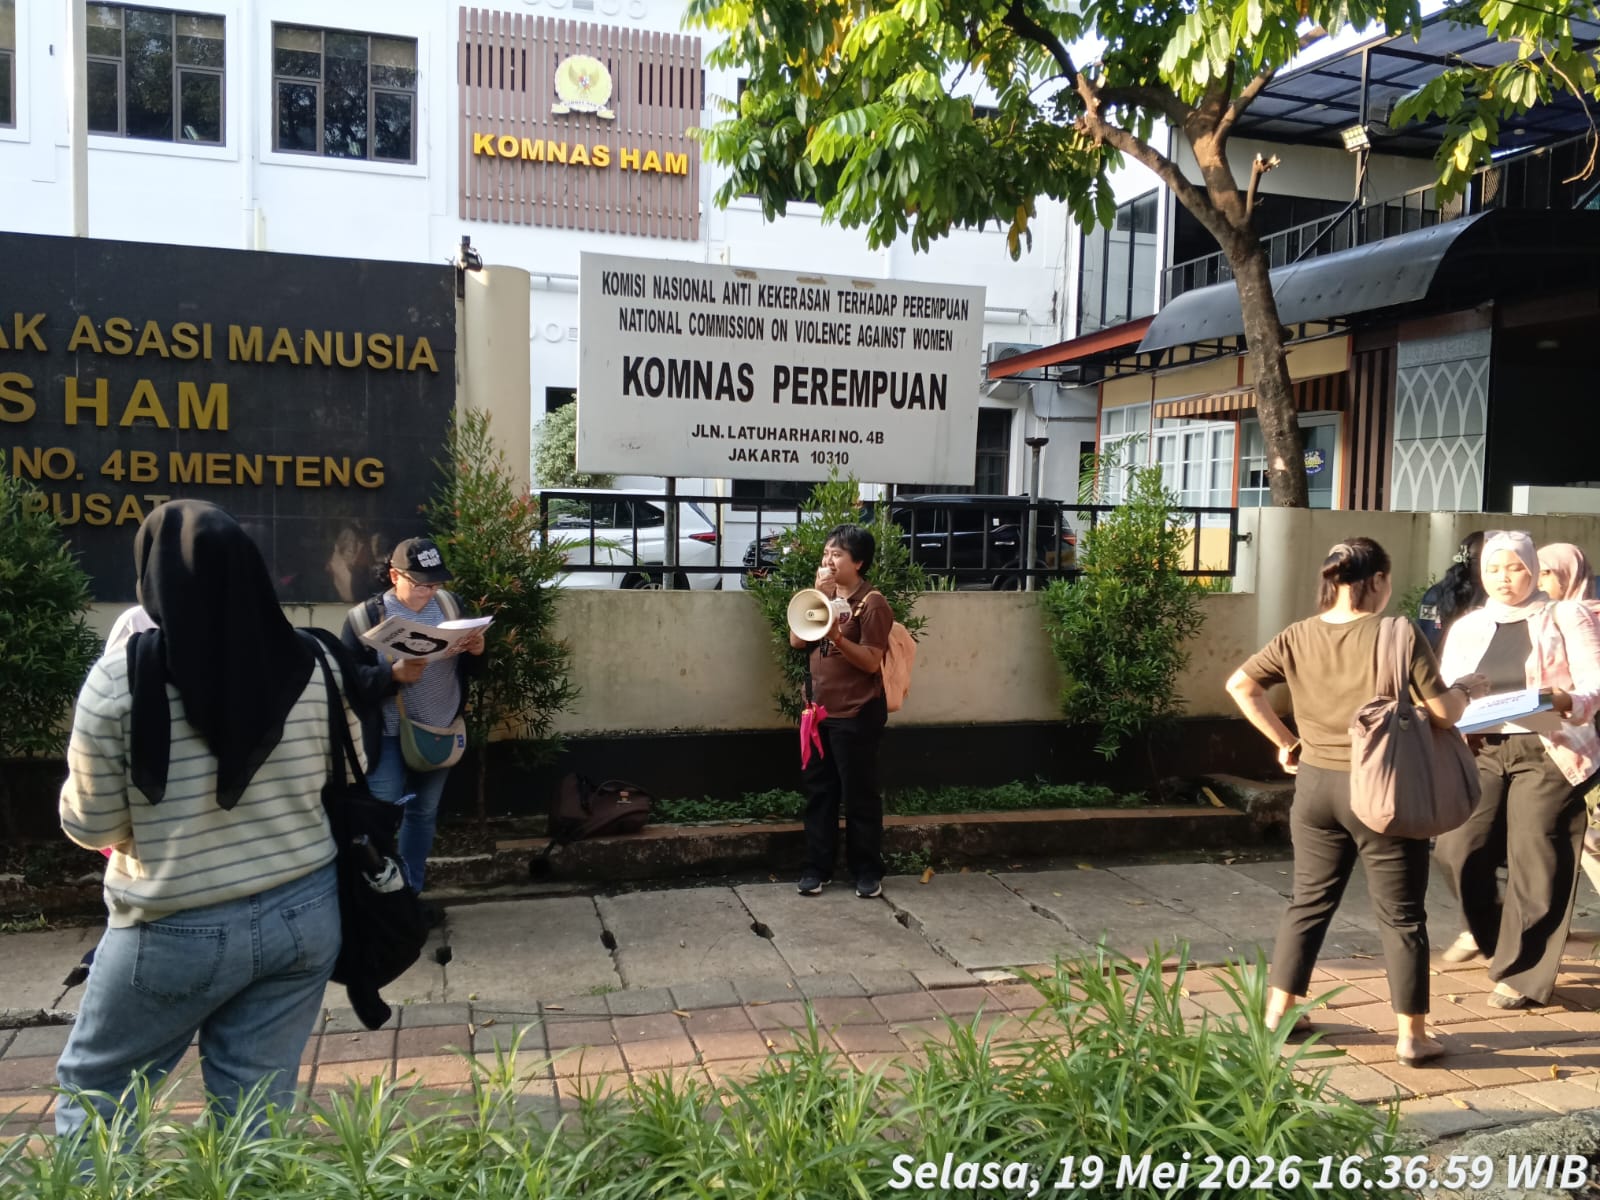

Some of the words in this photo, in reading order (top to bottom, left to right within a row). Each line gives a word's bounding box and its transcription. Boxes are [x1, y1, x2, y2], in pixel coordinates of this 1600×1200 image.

[473, 132, 611, 167] KOMNAS
[619, 147, 688, 175] HAM
[602, 271, 646, 298] KOMISI
[653, 275, 716, 304] NASIONAL
[722, 281, 752, 306] ANTI
[758, 283, 831, 313] KEKERASAN
[837, 291, 898, 316] TERHADAP
[903, 295, 969, 321] PEREMPUAN
[0, 312, 48, 352] K
[67, 315, 213, 360] ASASI
[228, 324, 439, 373] MANUSIA
[619, 307, 682, 335] NATIONAL
[688, 312, 764, 341] COMMISSION
[771, 318, 788, 342] ON
[795, 320, 851, 346] VIOLENCE
[857, 324, 906, 349] AGAINST
[913, 328, 953, 351] WOMEN
[64, 376, 229, 431] HAM
[622, 355, 754, 403] KOMNAS
[773, 365, 948, 411] PEREMPUAN
[691, 424, 724, 439] JLN.
[727, 425, 836, 443] LATUHARHARI
[838, 430, 863, 444] NO.
[866, 431, 884, 444] 4B
[12, 446, 84, 481] NO.
[101, 449, 160, 483] 4B
[168, 451, 385, 489] MENTENG
[728, 448, 800, 464] JAKARTA
[810, 451, 849, 465] 10310
